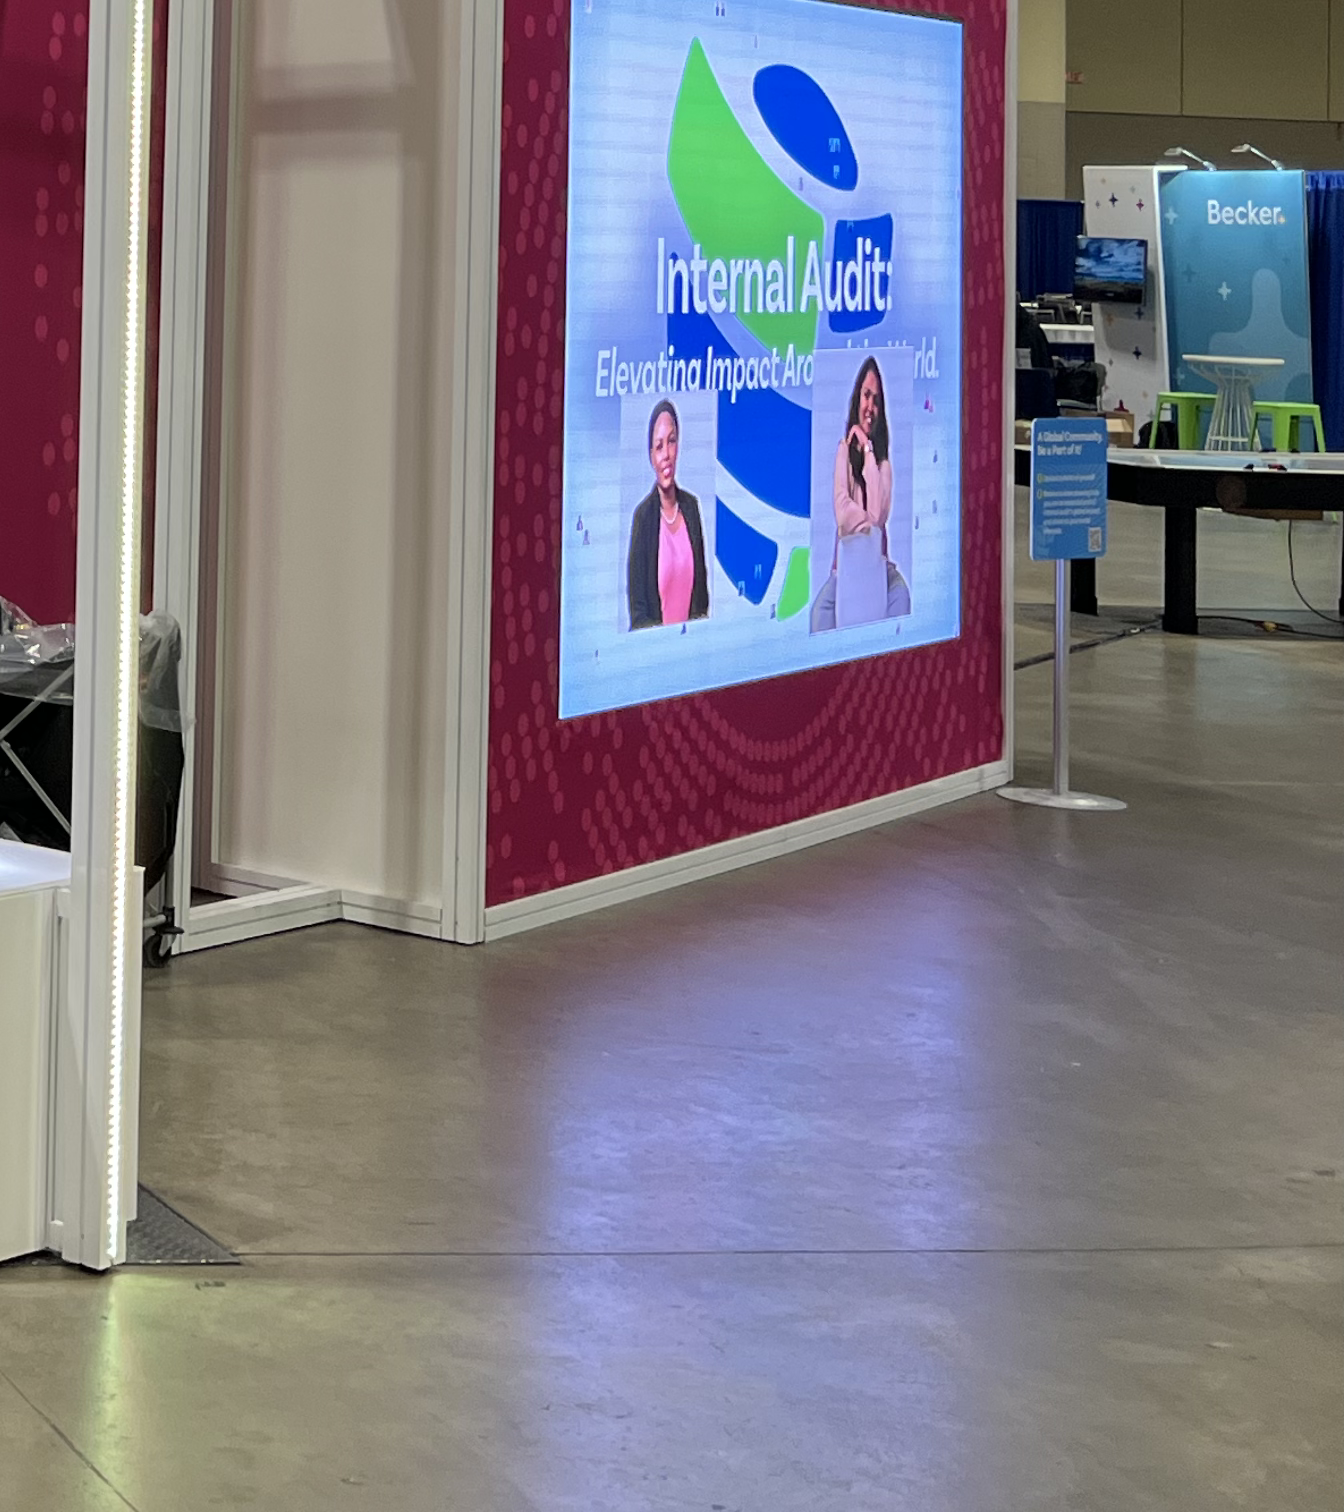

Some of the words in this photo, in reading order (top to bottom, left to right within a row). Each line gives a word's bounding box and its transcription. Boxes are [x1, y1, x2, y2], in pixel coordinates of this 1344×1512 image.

[657, 236, 795, 314] Internal
[799, 237, 893, 313] Audit:
[706, 346, 780, 404] Impact
